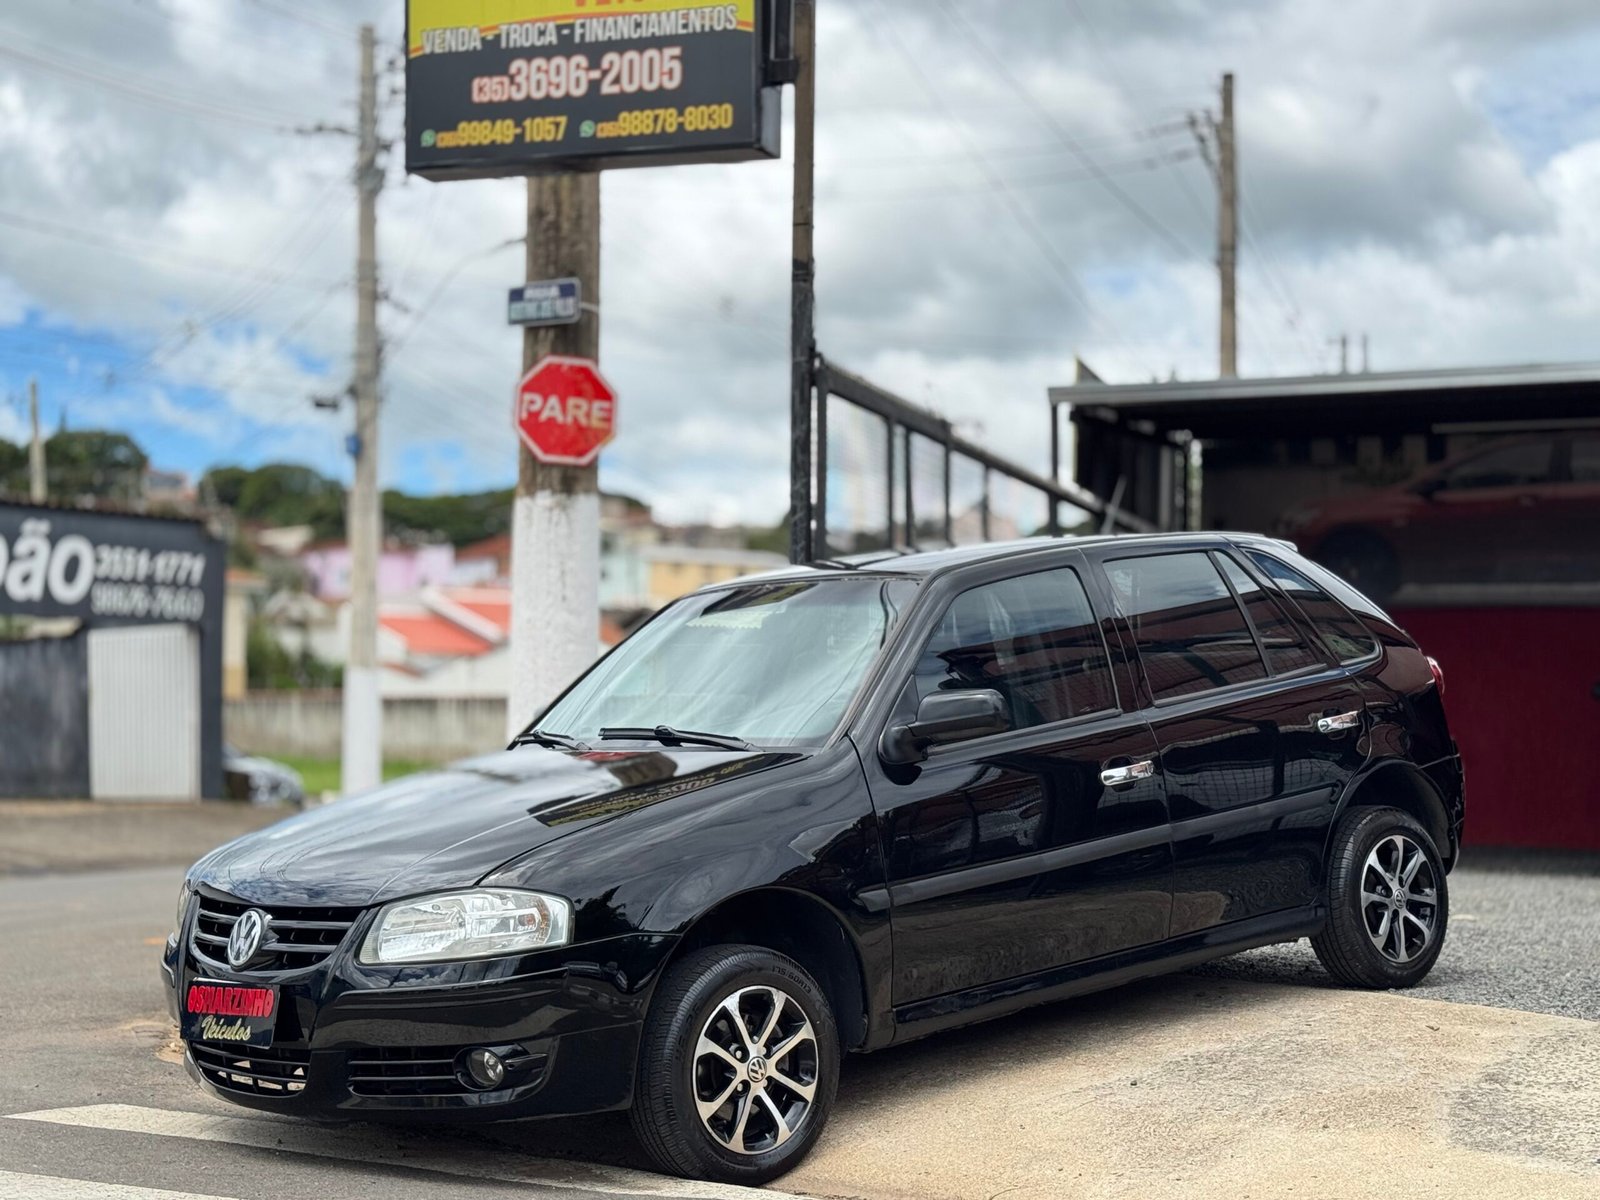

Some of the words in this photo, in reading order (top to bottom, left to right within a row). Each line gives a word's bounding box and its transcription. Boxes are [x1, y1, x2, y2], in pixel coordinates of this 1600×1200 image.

[421, 26, 482, 55] VENDA
[499, 23, 559, 49] TROCA
[573, 5, 738, 44] FINANCIAMENTOS
[471, 47, 683, 103] (35)3696-2005
[521, 392, 612, 429] PARE
[0, 517, 95, 605] ão
